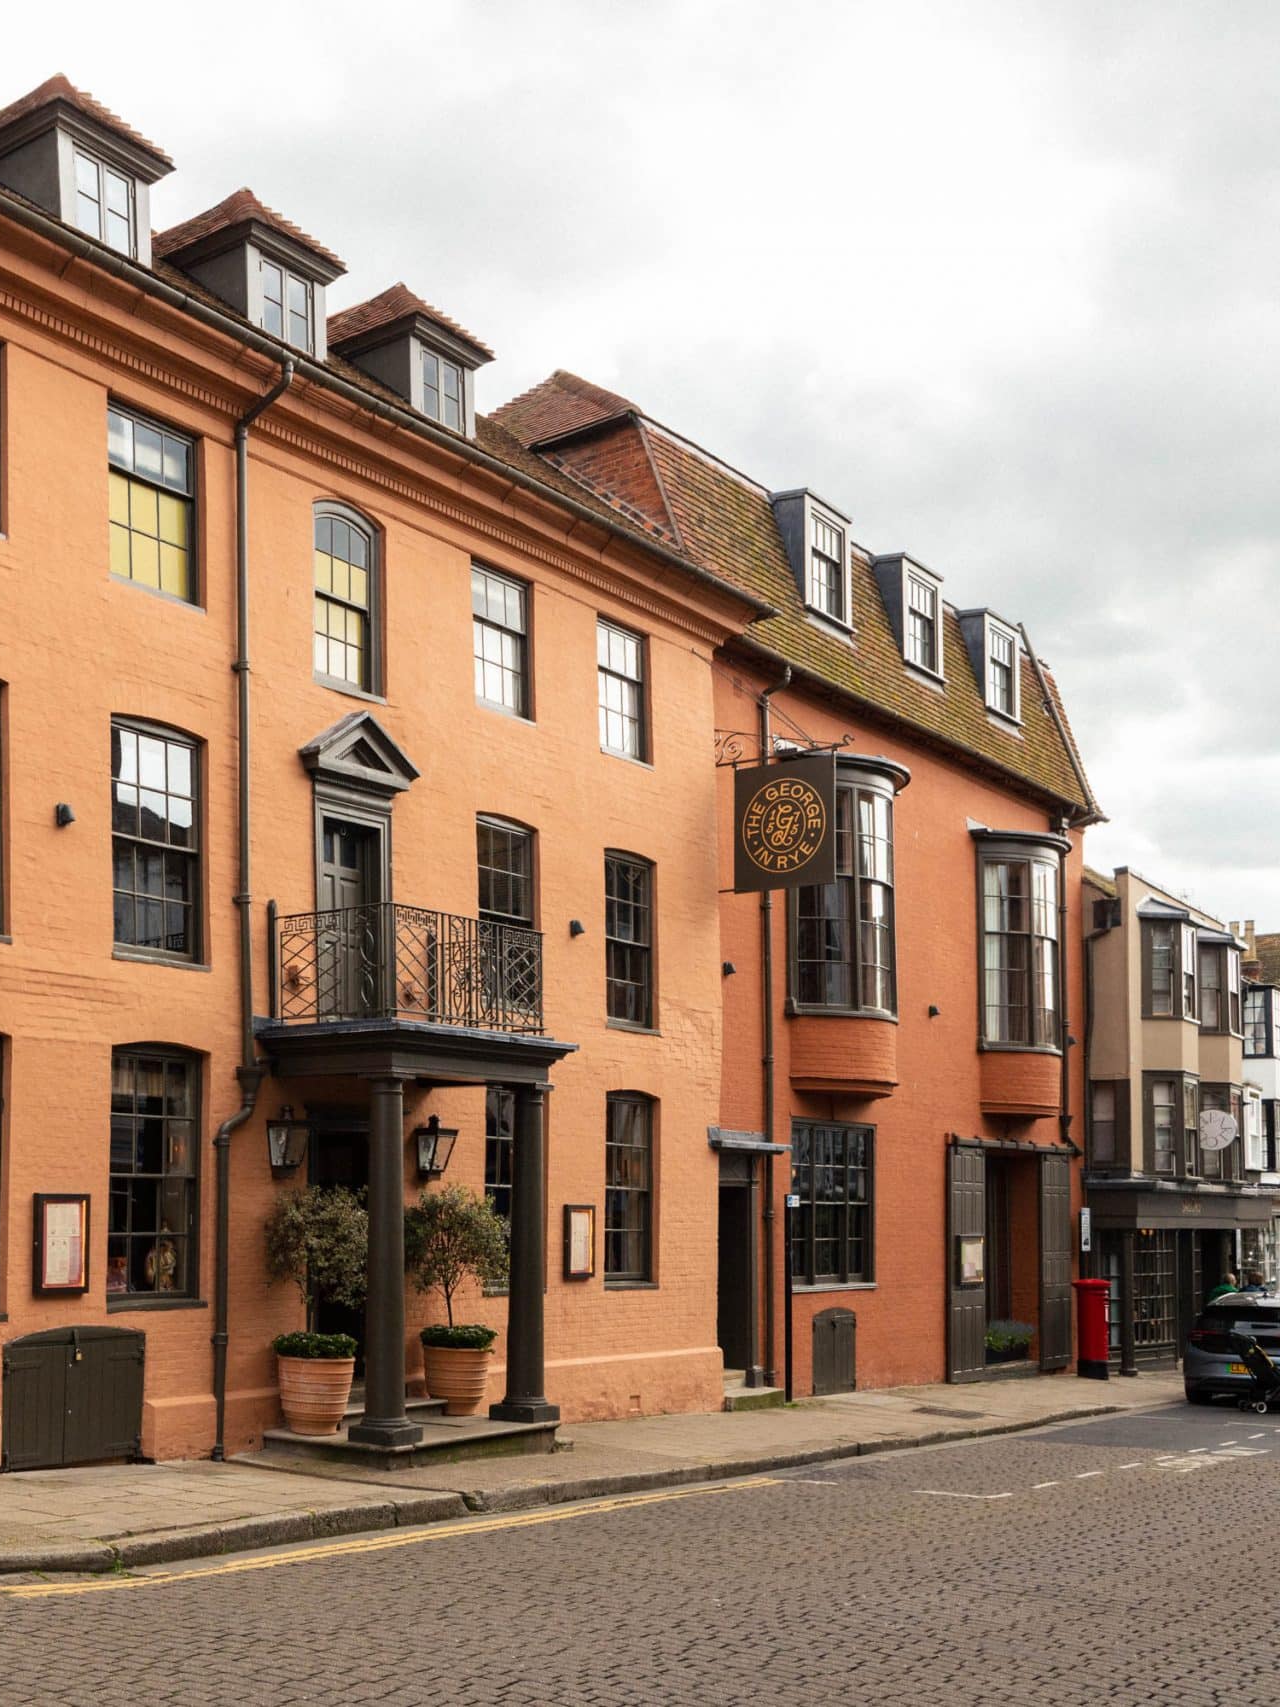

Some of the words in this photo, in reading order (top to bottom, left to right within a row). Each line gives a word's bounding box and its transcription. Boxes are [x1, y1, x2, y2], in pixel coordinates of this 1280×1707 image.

[747, 801, 766, 839] THE
[765, 783, 821, 829] GEORGE
[753, 846, 774, 866] IN
[776, 841, 814, 869] RYE
